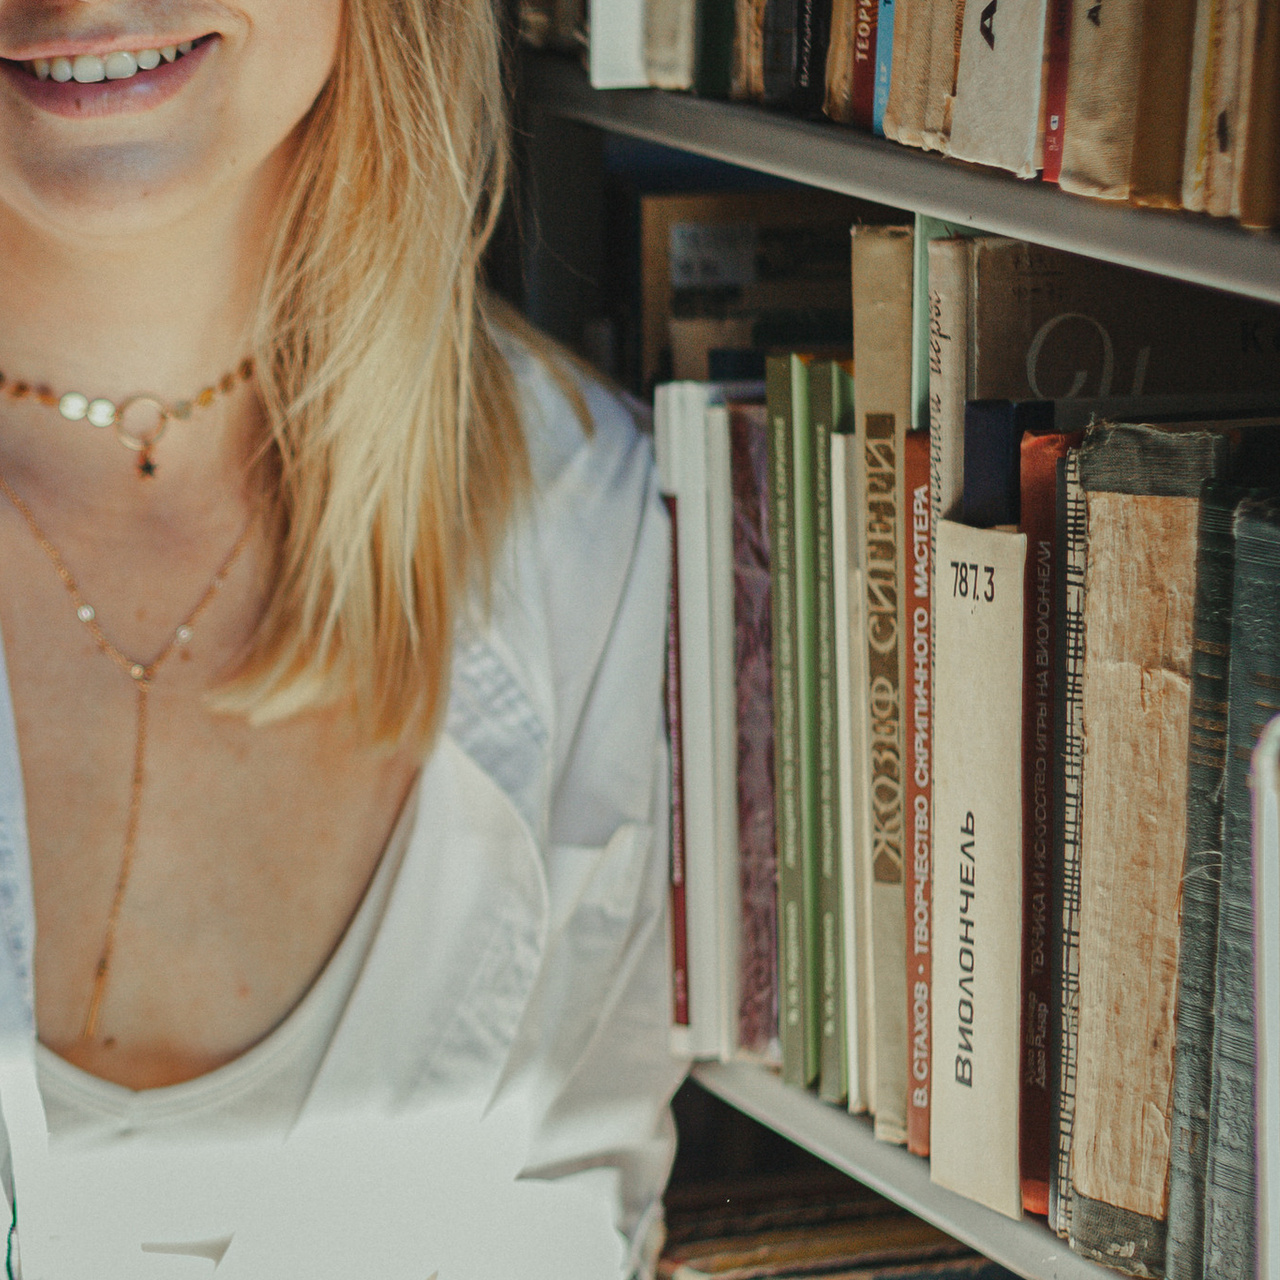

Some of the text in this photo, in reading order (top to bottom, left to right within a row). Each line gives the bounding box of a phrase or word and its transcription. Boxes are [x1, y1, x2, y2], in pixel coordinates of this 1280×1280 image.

[866, 433, 902, 866] ЖОЗЕФ СИГЕТИ
[912, 484, 930, 1108] В. СТАХОВ ТВОРЧЕСТВО СКРИПИЧНОГО МАСТЕРА
[950, 561, 995, 602] 787.3
[1030, 540, 1052, 976] ТЕХНИКА И ИСКУССТВО ИГРЫ НА ВИОЛОНЧЕЛИ
